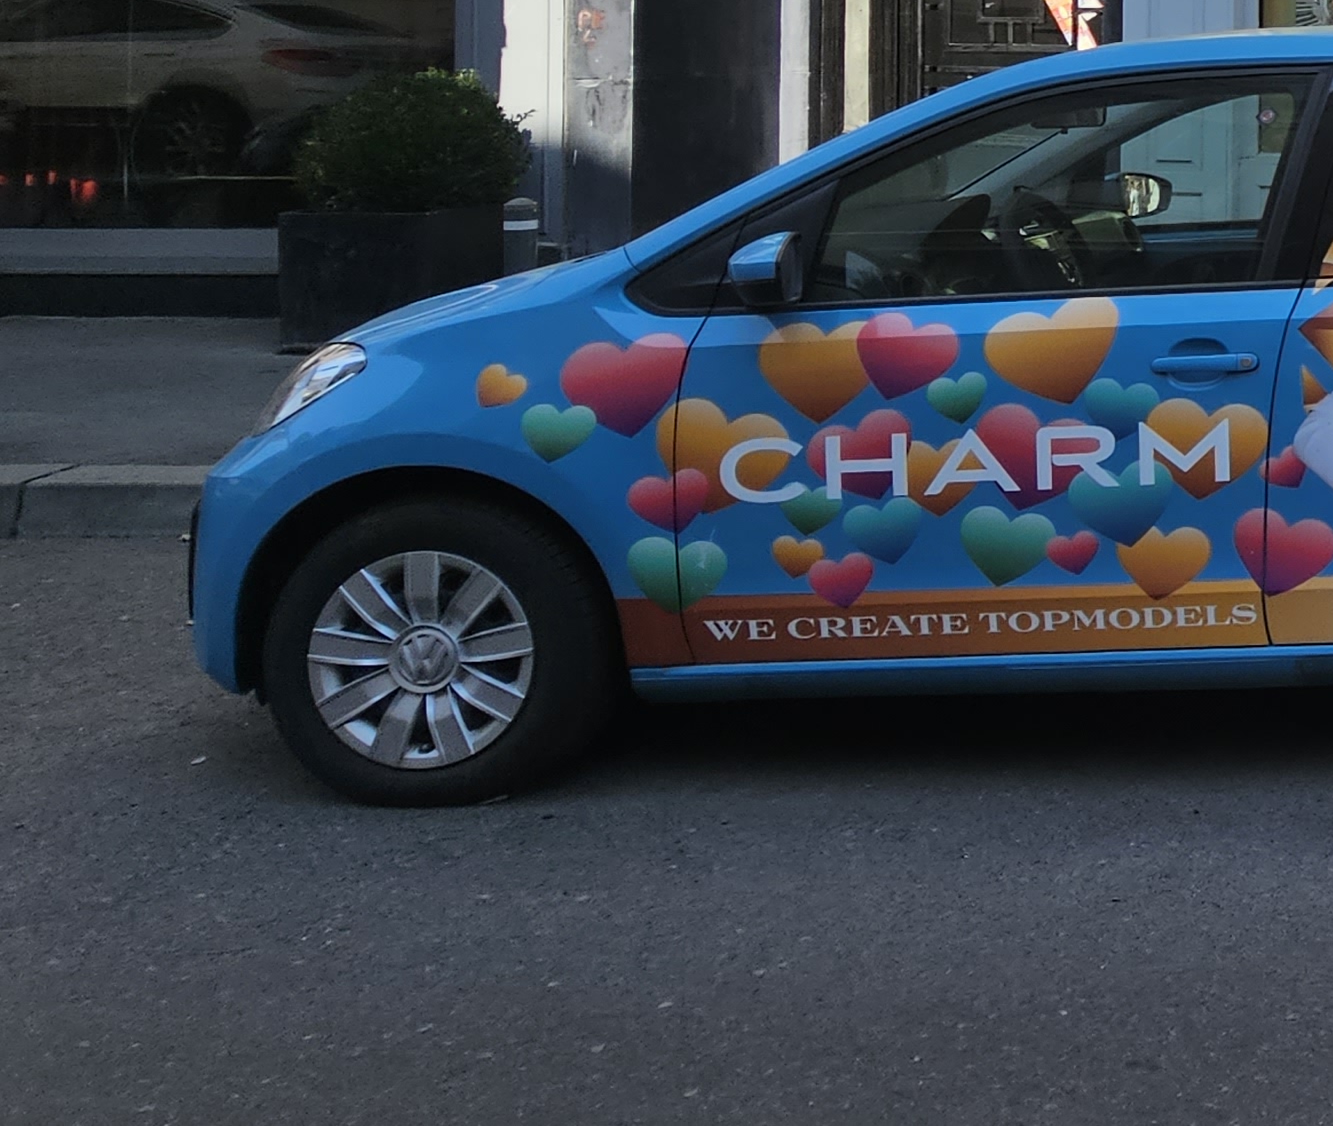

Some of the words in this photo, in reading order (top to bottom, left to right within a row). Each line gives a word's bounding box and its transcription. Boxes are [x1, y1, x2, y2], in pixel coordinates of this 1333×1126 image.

[719, 418, 1232, 504] CHARM
[703, 619, 777, 642] WE
[787, 612, 971, 639] CREATE
[978, 604, 1259, 635] TOPMODELS
